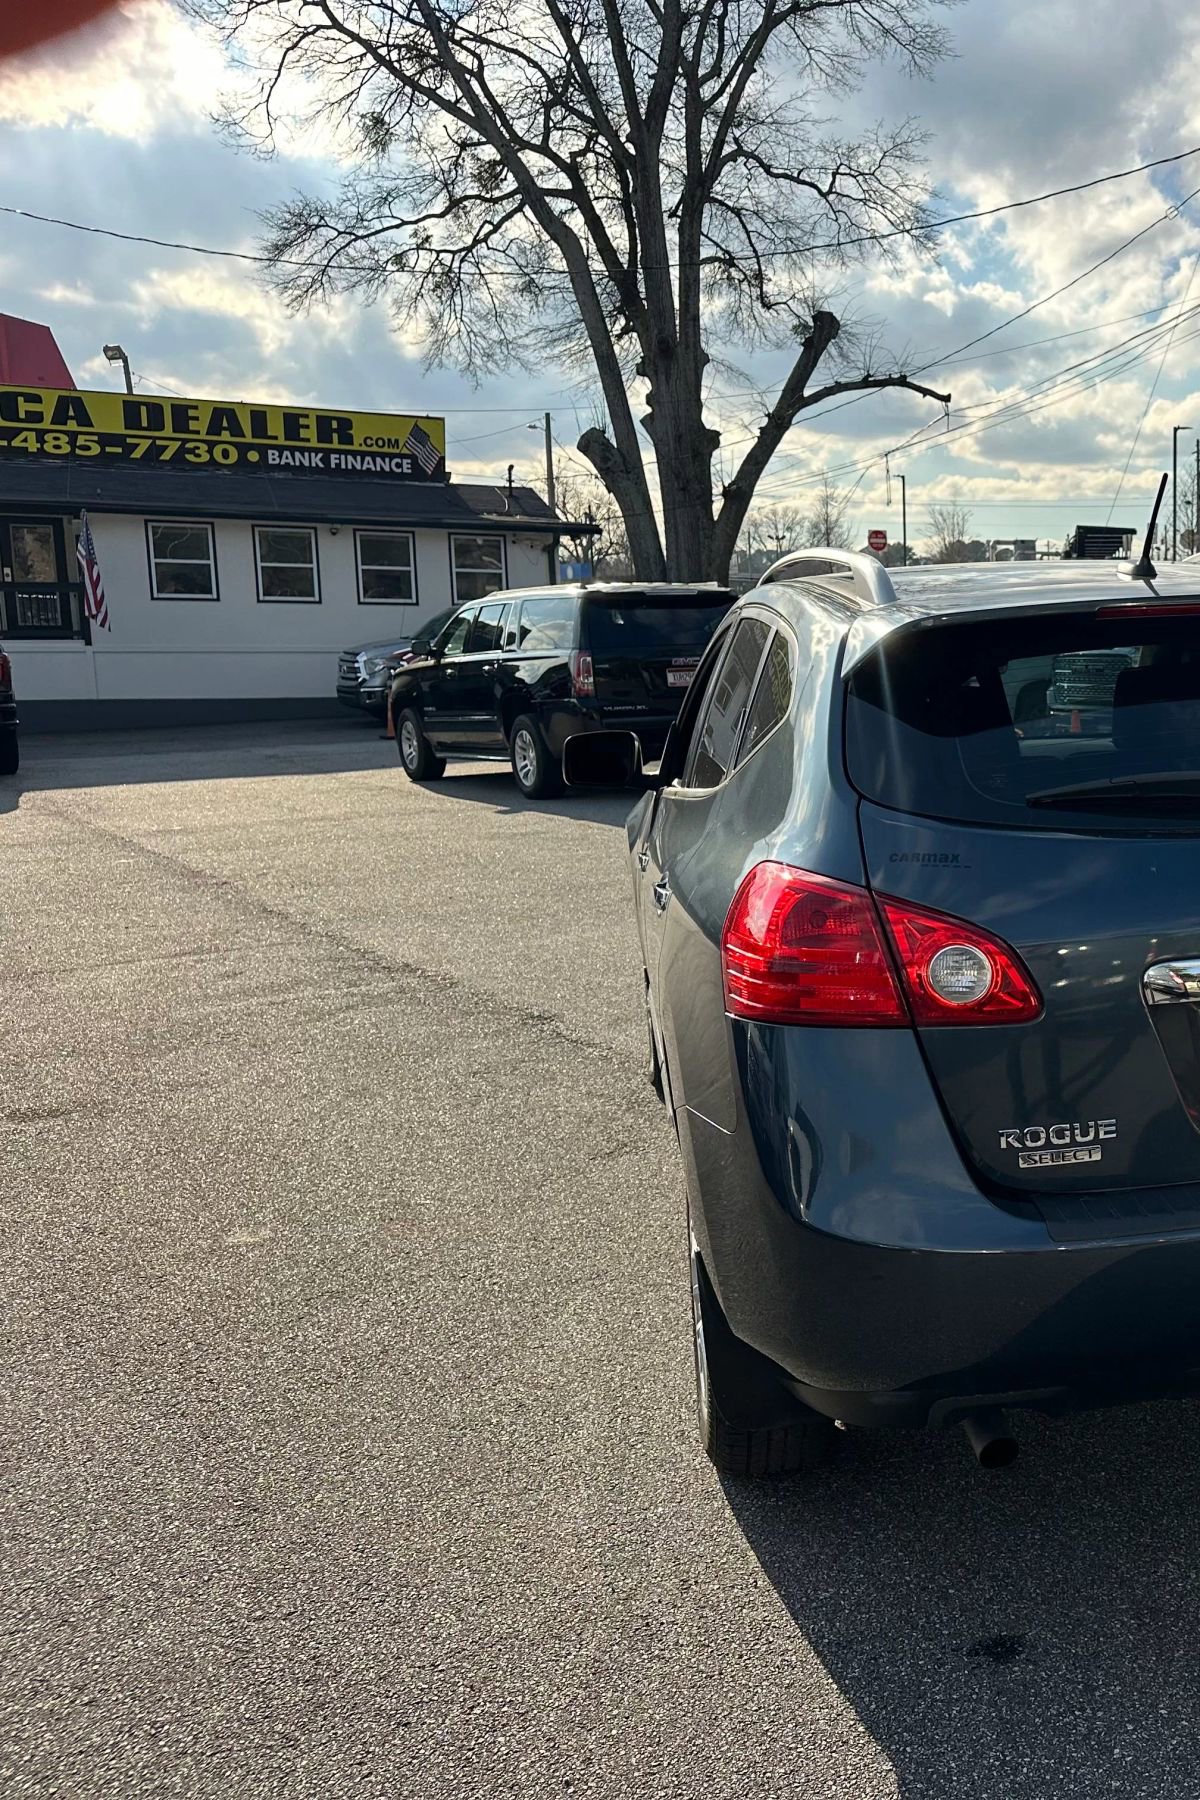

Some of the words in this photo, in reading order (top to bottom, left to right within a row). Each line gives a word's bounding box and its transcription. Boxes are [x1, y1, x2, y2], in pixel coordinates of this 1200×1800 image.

[122, 399, 354, 446] DEALER
[267, 449, 325, 468] BANK
[330, 453, 412, 473] FINANCE
[998, 1118, 1117, 1149] ROGUE
[1023, 1147, 1096, 1166] SELECT
